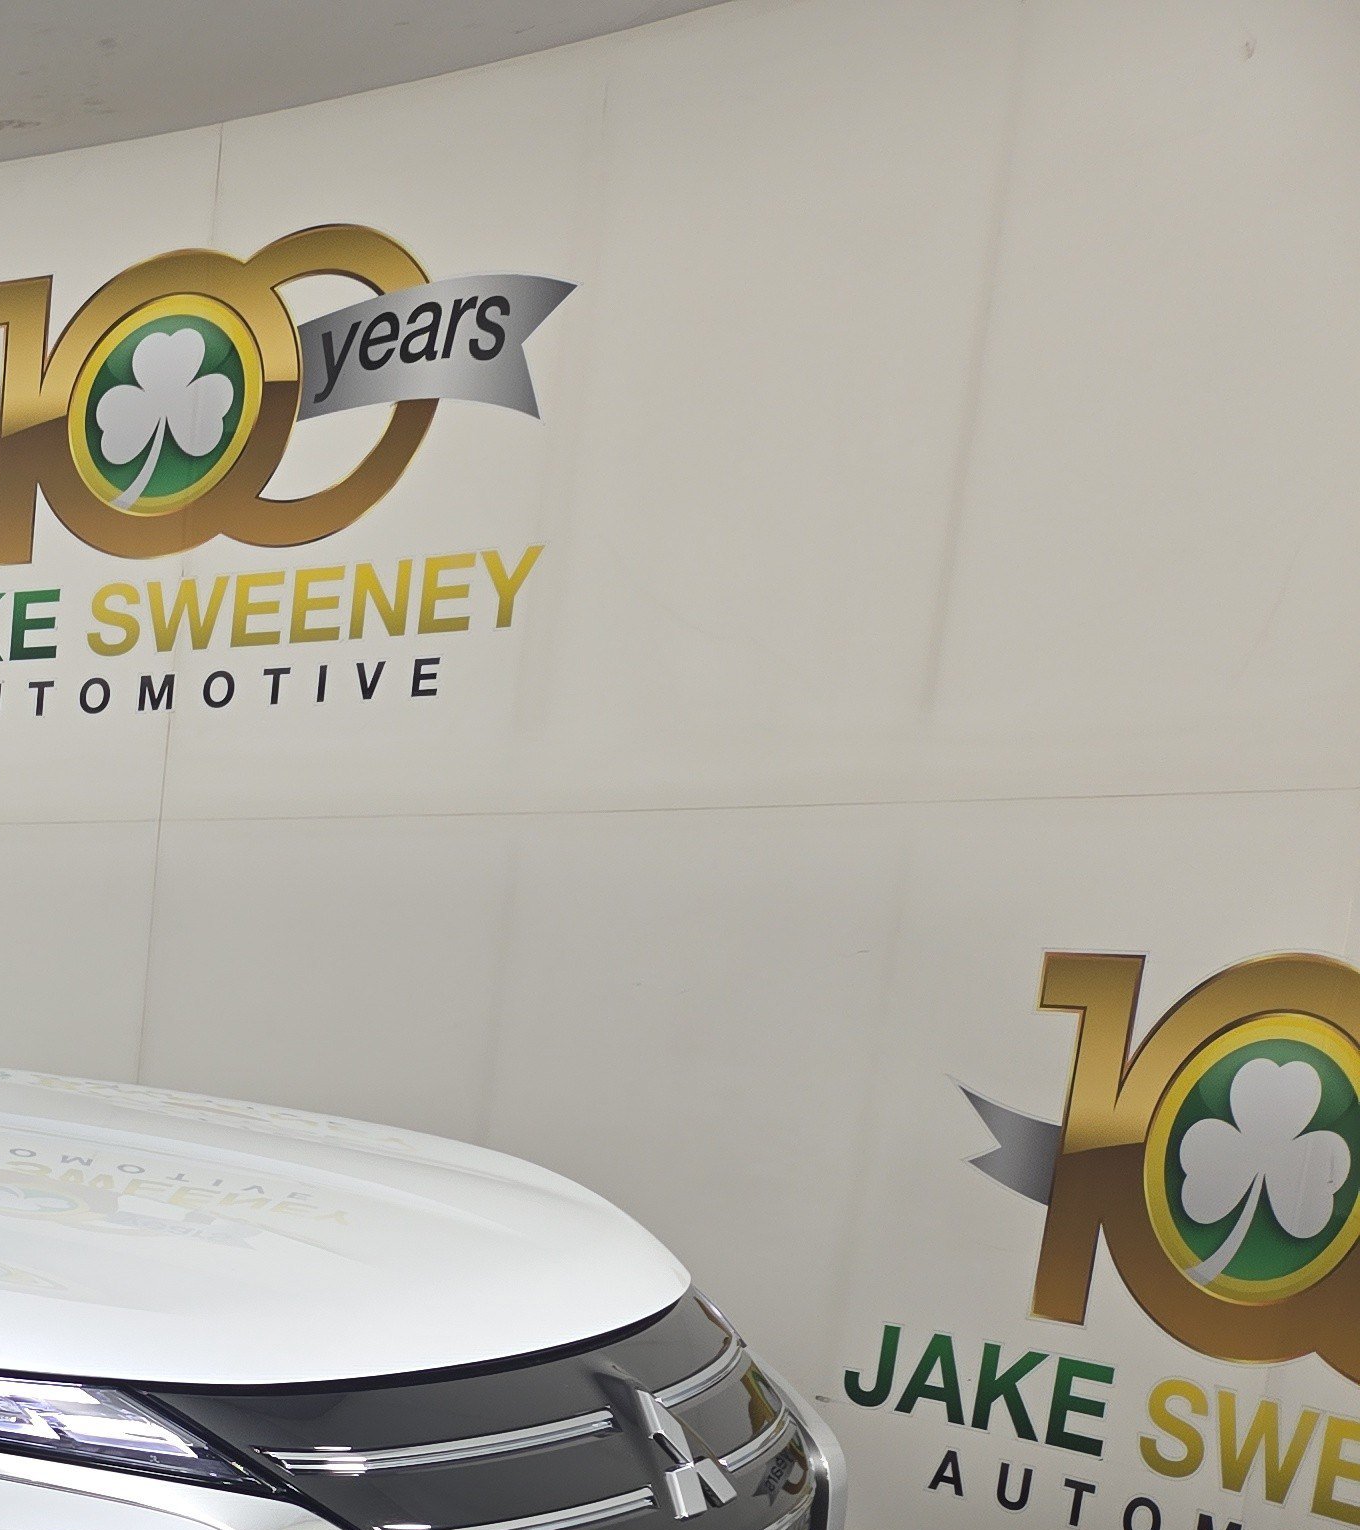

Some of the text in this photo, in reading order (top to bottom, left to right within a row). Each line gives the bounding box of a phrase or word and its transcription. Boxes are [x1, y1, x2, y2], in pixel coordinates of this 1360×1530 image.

[313, 291, 511, 403] years
[86, 544, 546, 658] SWEENEY
[1030, 951, 1360, 1386] 10
[843, 1324, 1115, 1457] JAKE
